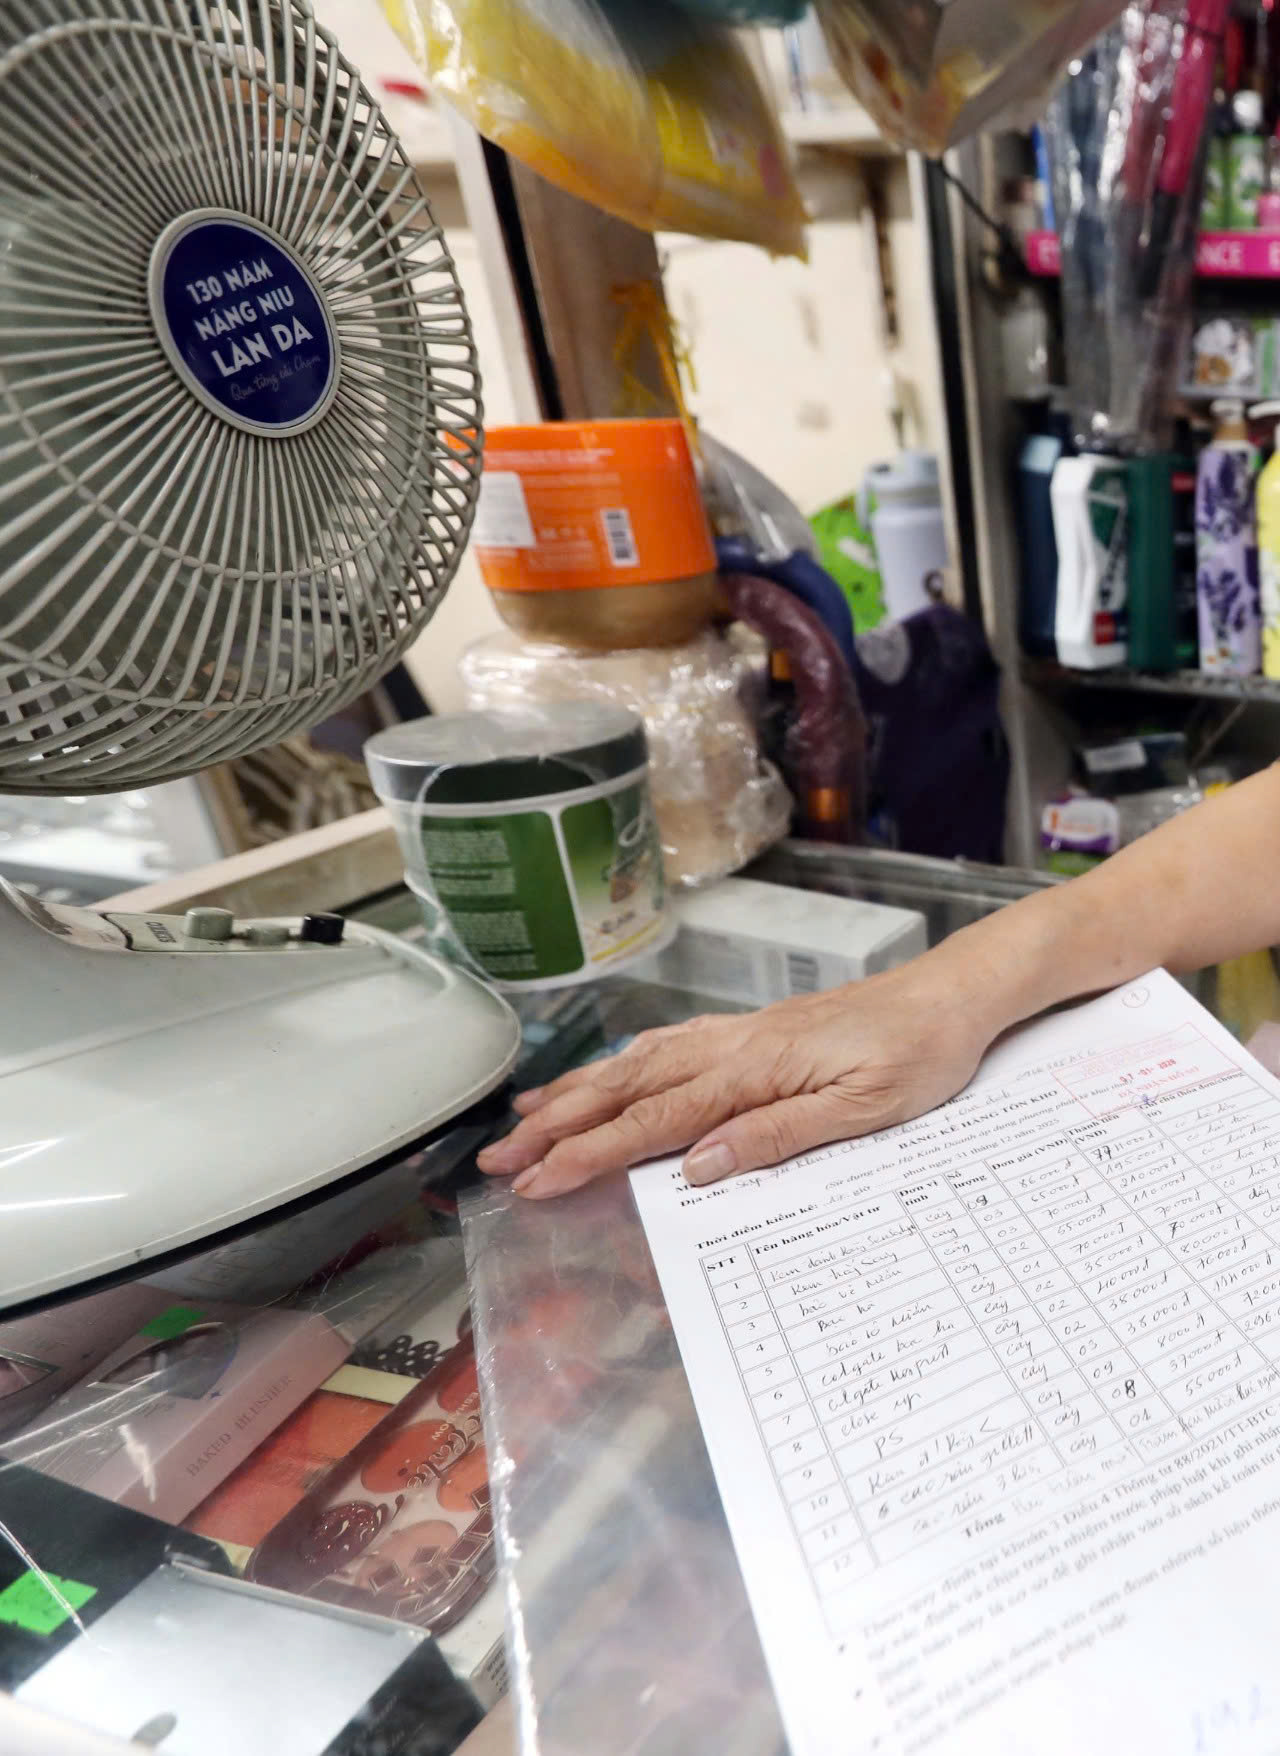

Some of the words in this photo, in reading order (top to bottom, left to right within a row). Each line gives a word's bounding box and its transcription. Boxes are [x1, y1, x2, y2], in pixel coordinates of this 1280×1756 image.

[185, 275, 224, 305] 130
[193, 300, 258, 341] NÂNG
[256, 285, 295, 316] NIU
[211, 332, 272, 378] LÀN
[270, 315, 314, 352] DA
[1030, 1089, 1058, 1104] KHO
[694, 1234, 729, 1250] Thời
[730, 1220, 763, 1240] điểm
[765, 1208, 797, 1226] kiểm
[1013, 1127, 1036, 1140] năm
[680, 1195, 702, 1208] Địa
[753, 1241, 779, 1256] Tên
[782, 1230, 814, 1250] hàng
[705, 1256, 737, 1273] STT
[732, 1281, 740, 1290] 1
[740, 1301, 749, 1311] 2
[747, 1321, 756, 1331] 3
[755, 1343, 765, 1353] 4
[764, 1366, 773, 1376] 5
[773, 1390, 783, 1400] 6
[783, 1414, 792, 1425] 7
[186, 1433, 232, 1476] BAKED
